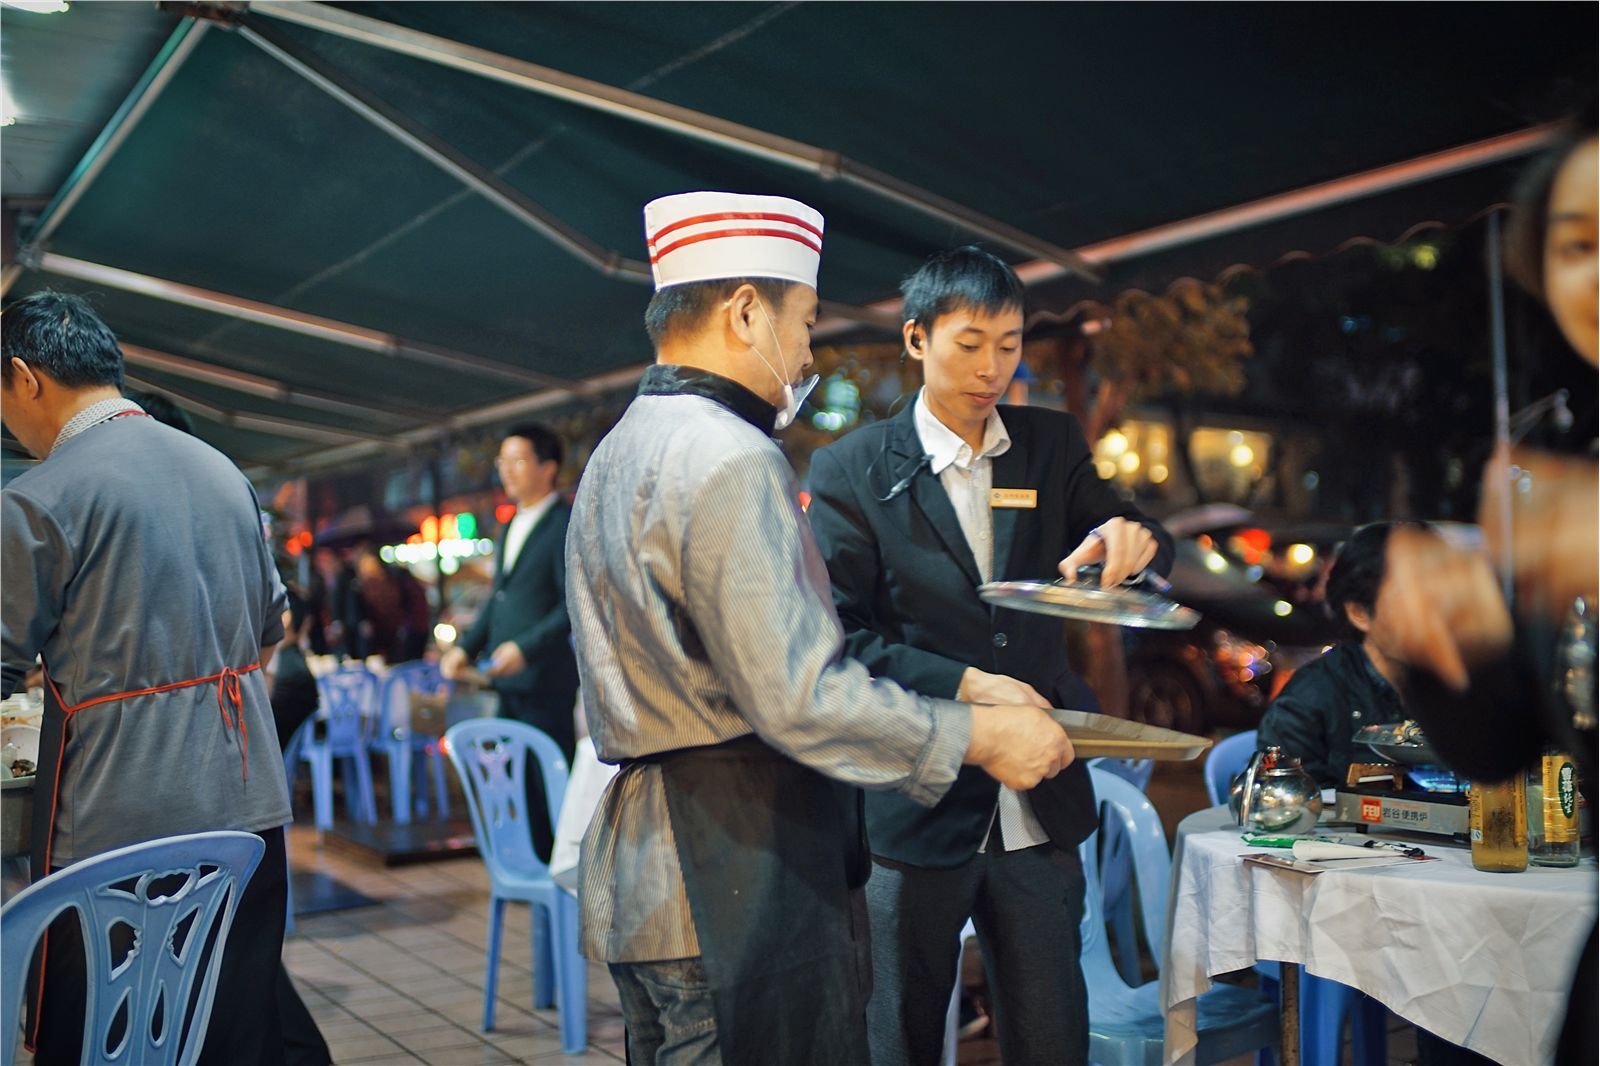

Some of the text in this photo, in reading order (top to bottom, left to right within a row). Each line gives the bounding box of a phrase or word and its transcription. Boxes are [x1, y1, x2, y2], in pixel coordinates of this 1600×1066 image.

[1383, 807, 1428, 822] 岩谷便携炉
